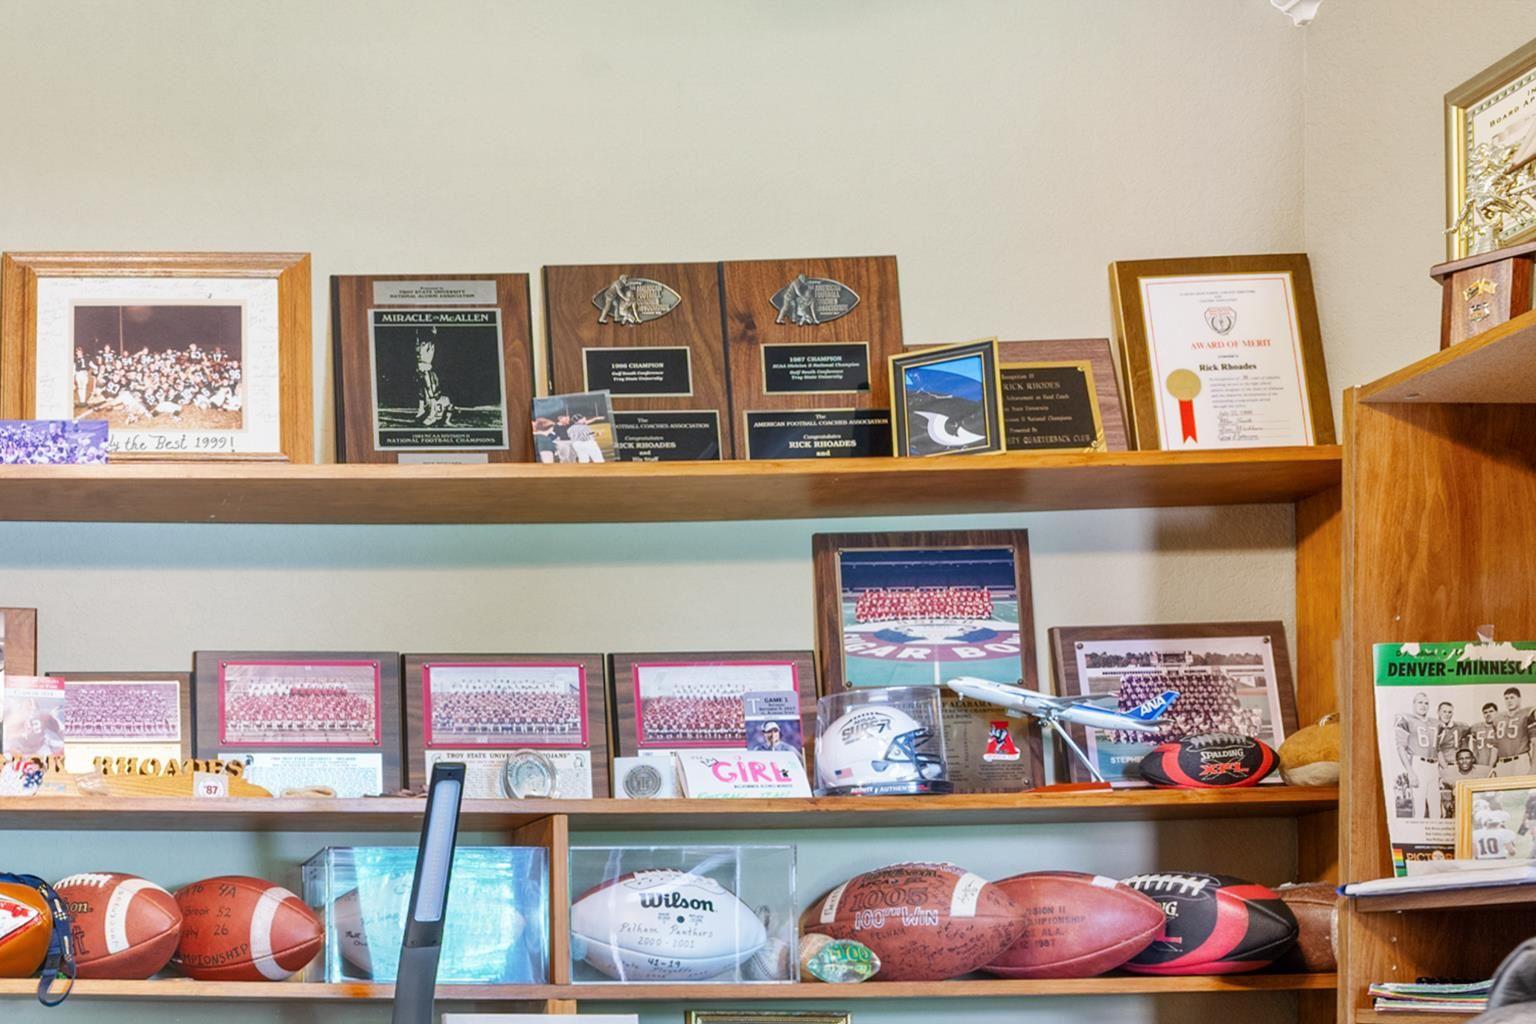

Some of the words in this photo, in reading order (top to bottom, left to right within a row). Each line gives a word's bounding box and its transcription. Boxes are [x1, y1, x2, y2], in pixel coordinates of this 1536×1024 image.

[382, 313, 432, 322] MIRACLE
[439, 313, 489, 322] McALLEN
[1191, 342, 1224, 350] AWARD
[1221, 362, 1257, 371] Rhoades
[124, 434, 146, 451] the
[149, 434, 188, 450] Best
[195, 436, 236, 453] 1999!
[1140, 695, 1166, 717] ANA
[1496, 718, 1519, 739] 85
[1110, 755, 1145, 764] STEPHE
[1200, 748, 1244, 761] SPALDING
[1199, 761, 1249, 777] XFL
[1478, 837, 1498, 855] 10
[639, 892, 715, 913] Wilson
[214, 924, 229, 936] 26
[619, 922, 658, 934] Pelham
[670, 925, 714, 939] Panthers
